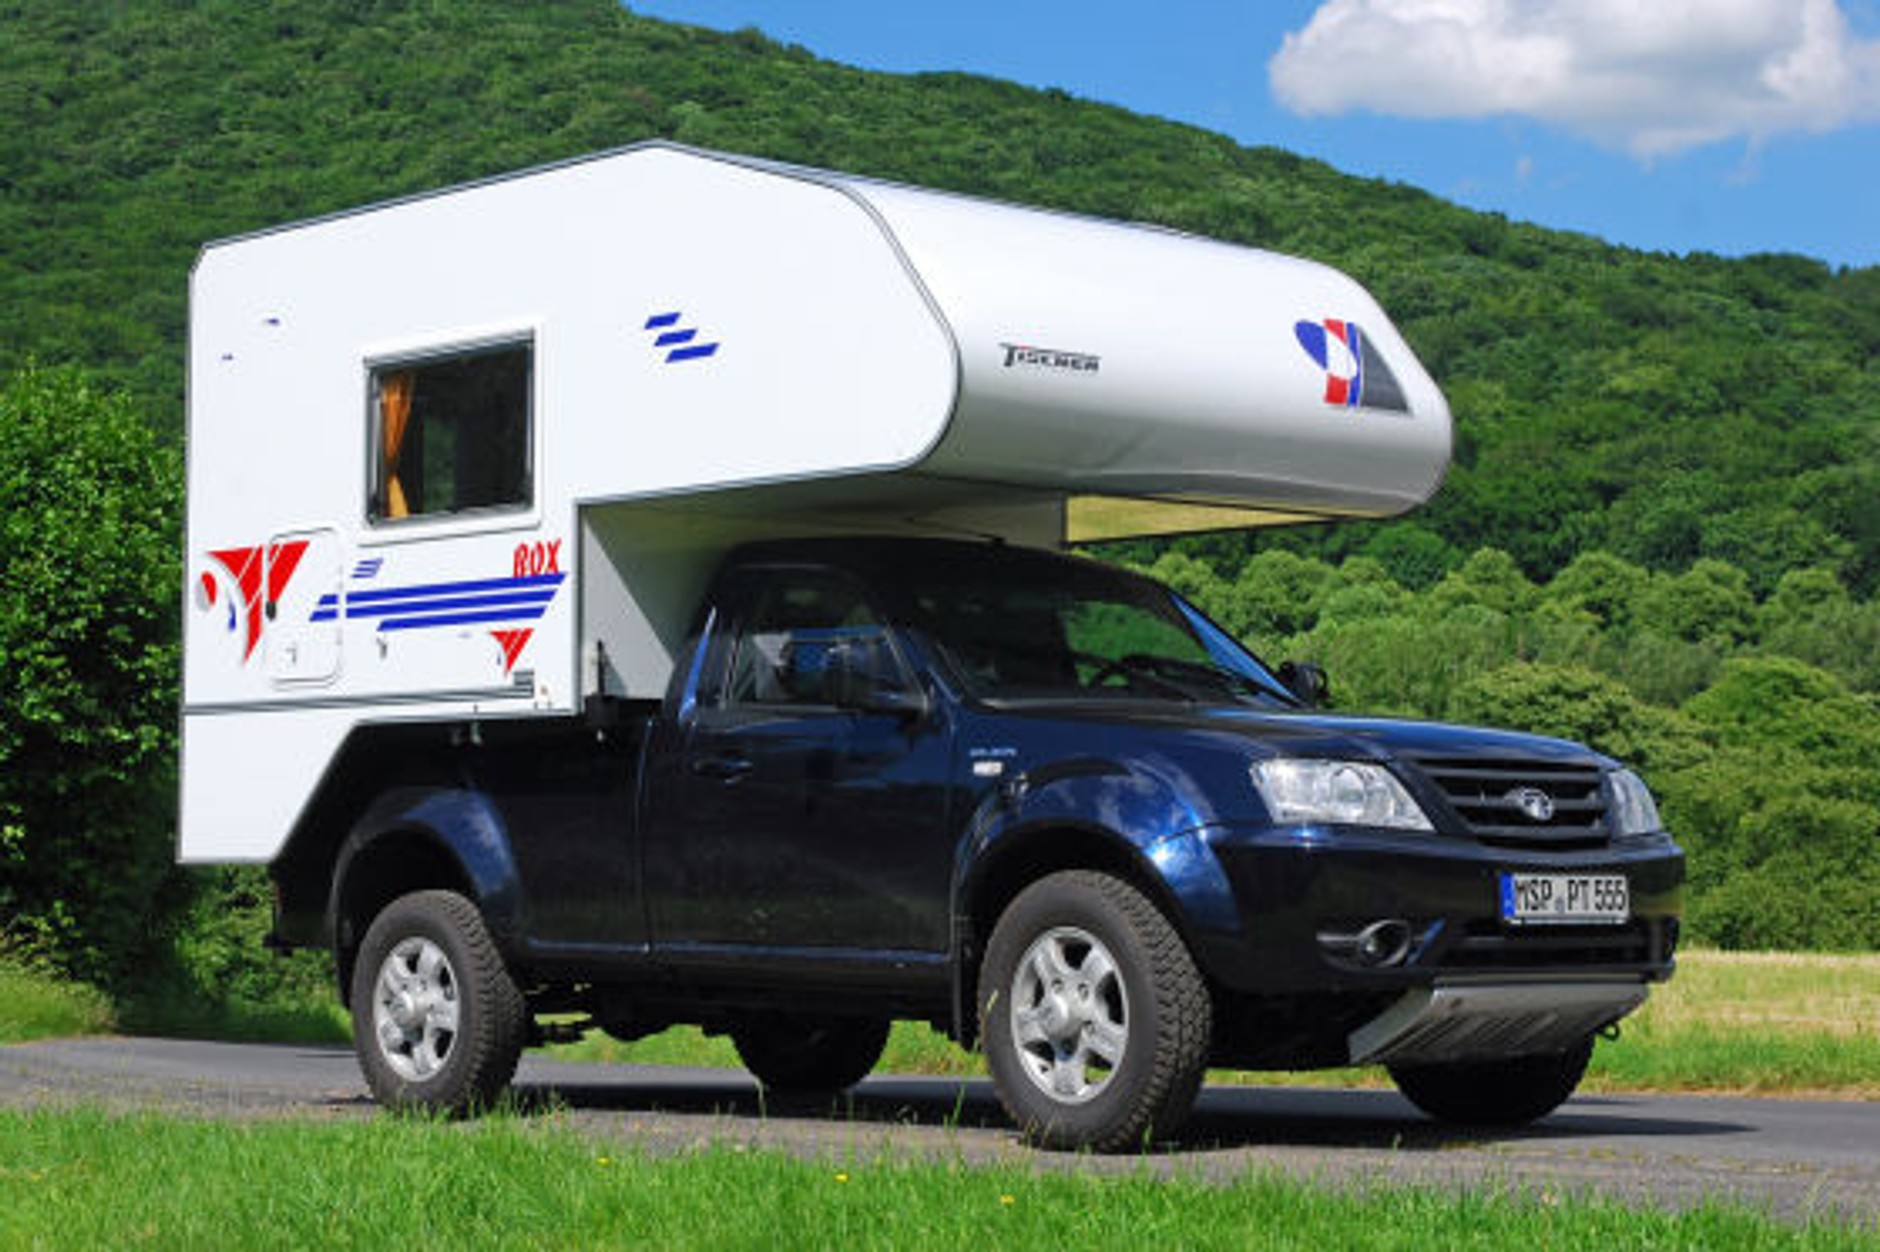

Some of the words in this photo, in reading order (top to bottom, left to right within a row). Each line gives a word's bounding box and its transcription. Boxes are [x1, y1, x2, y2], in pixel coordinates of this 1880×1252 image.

[1514, 879, 1552, 911] MSP
[1567, 879, 1590, 911] PT
[1594, 879, 1626, 911] 555
